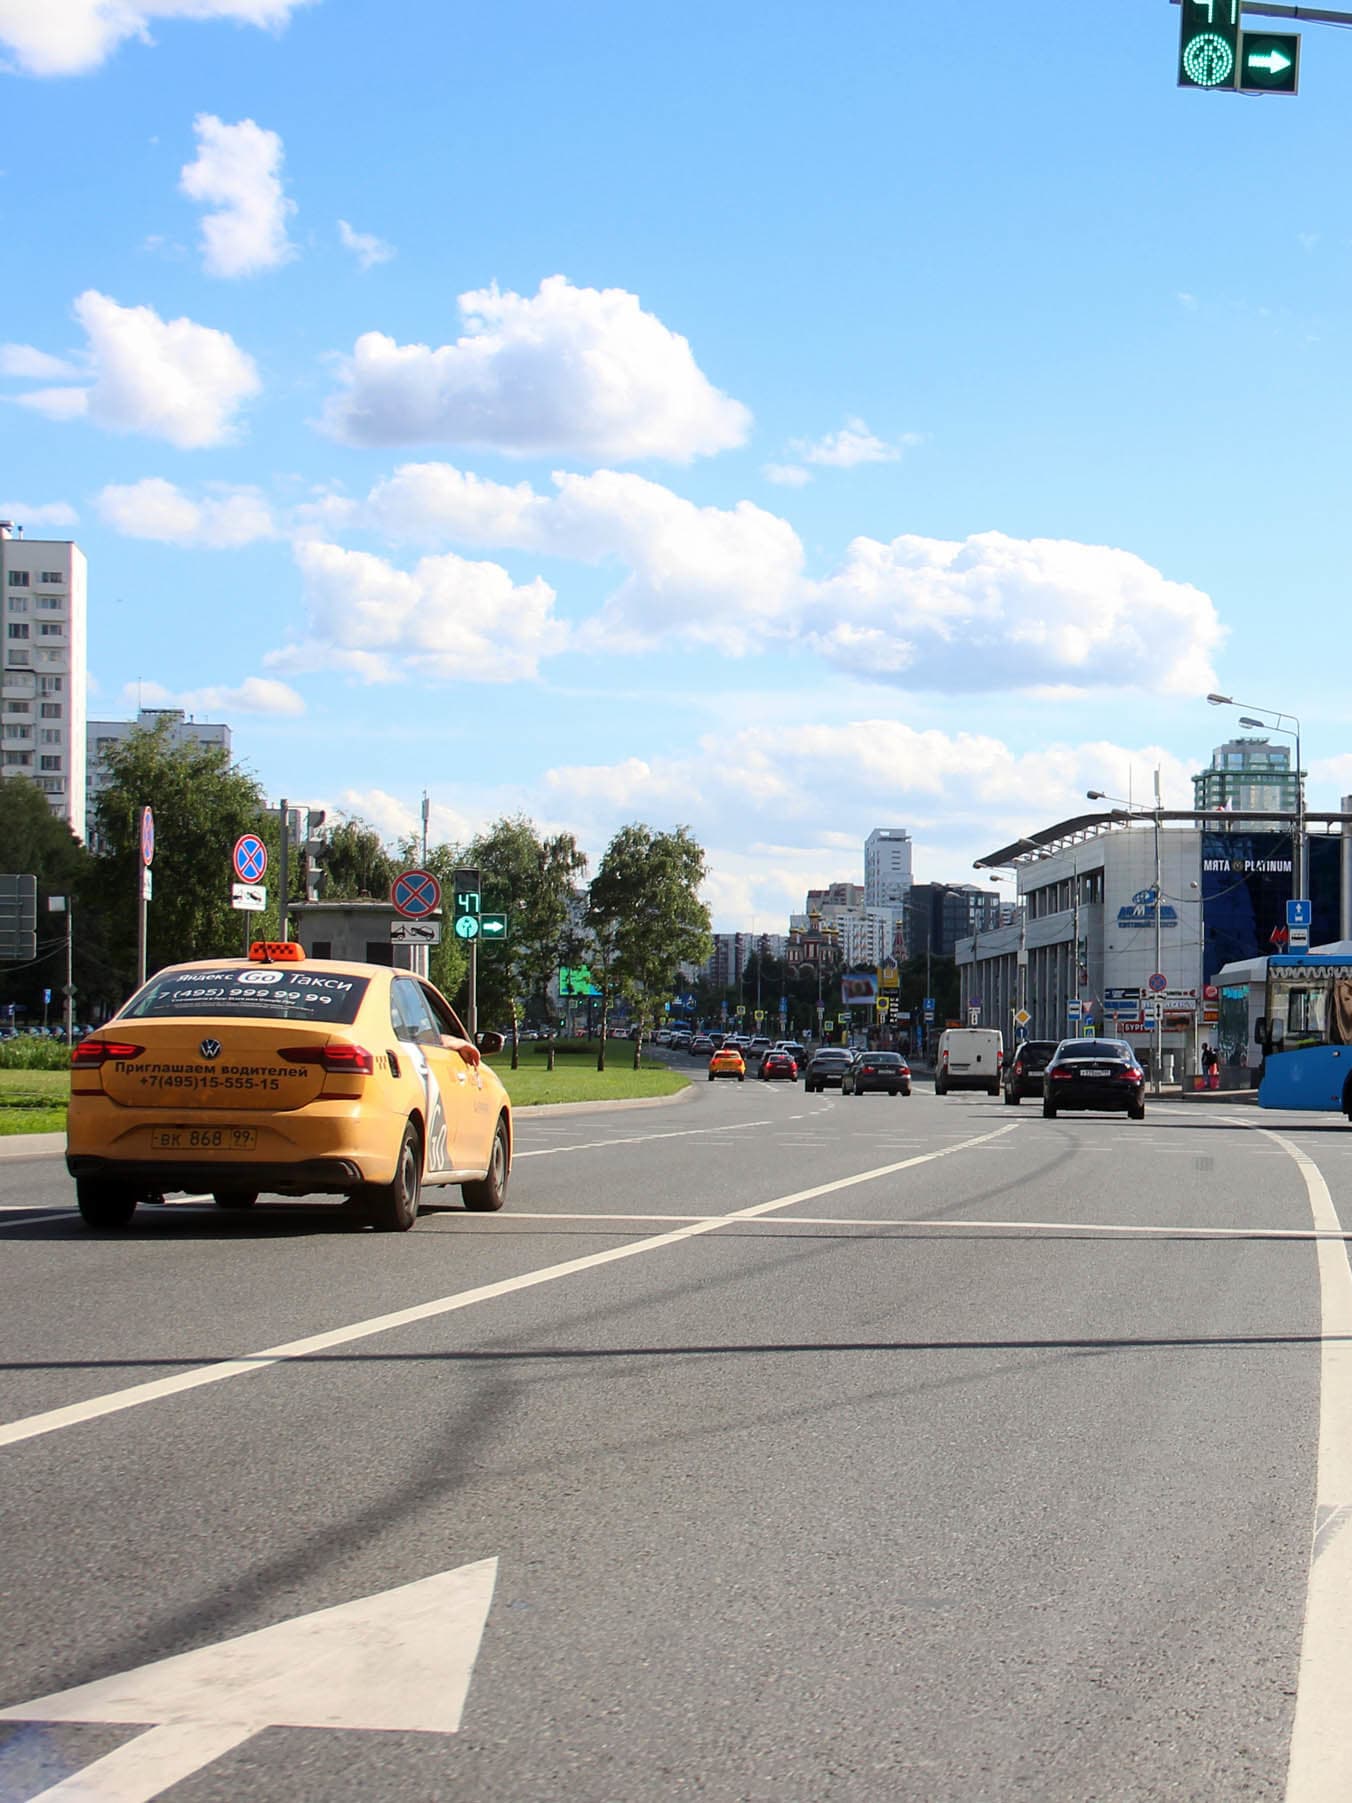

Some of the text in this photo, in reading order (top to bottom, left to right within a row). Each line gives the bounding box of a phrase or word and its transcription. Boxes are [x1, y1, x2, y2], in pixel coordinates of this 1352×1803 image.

[1203, 860, 1292, 872] МЯТА PLATINUM
[458, 893, 479, 913] 47
[176, 973, 234, 983] Яндекс
[289, 974, 353, 992] Такси
[173, 988, 225, 1000] (495)
[229, 988, 264, 999] 999
[273, 990, 302, 1000] 99
[305, 993, 332, 1005] 99
[115, 1062, 309, 1078] Приглашаем водителей
[140, 1075, 280, 1091] +7(495)15-555-15
[190, 1131, 222, 1147] 868
